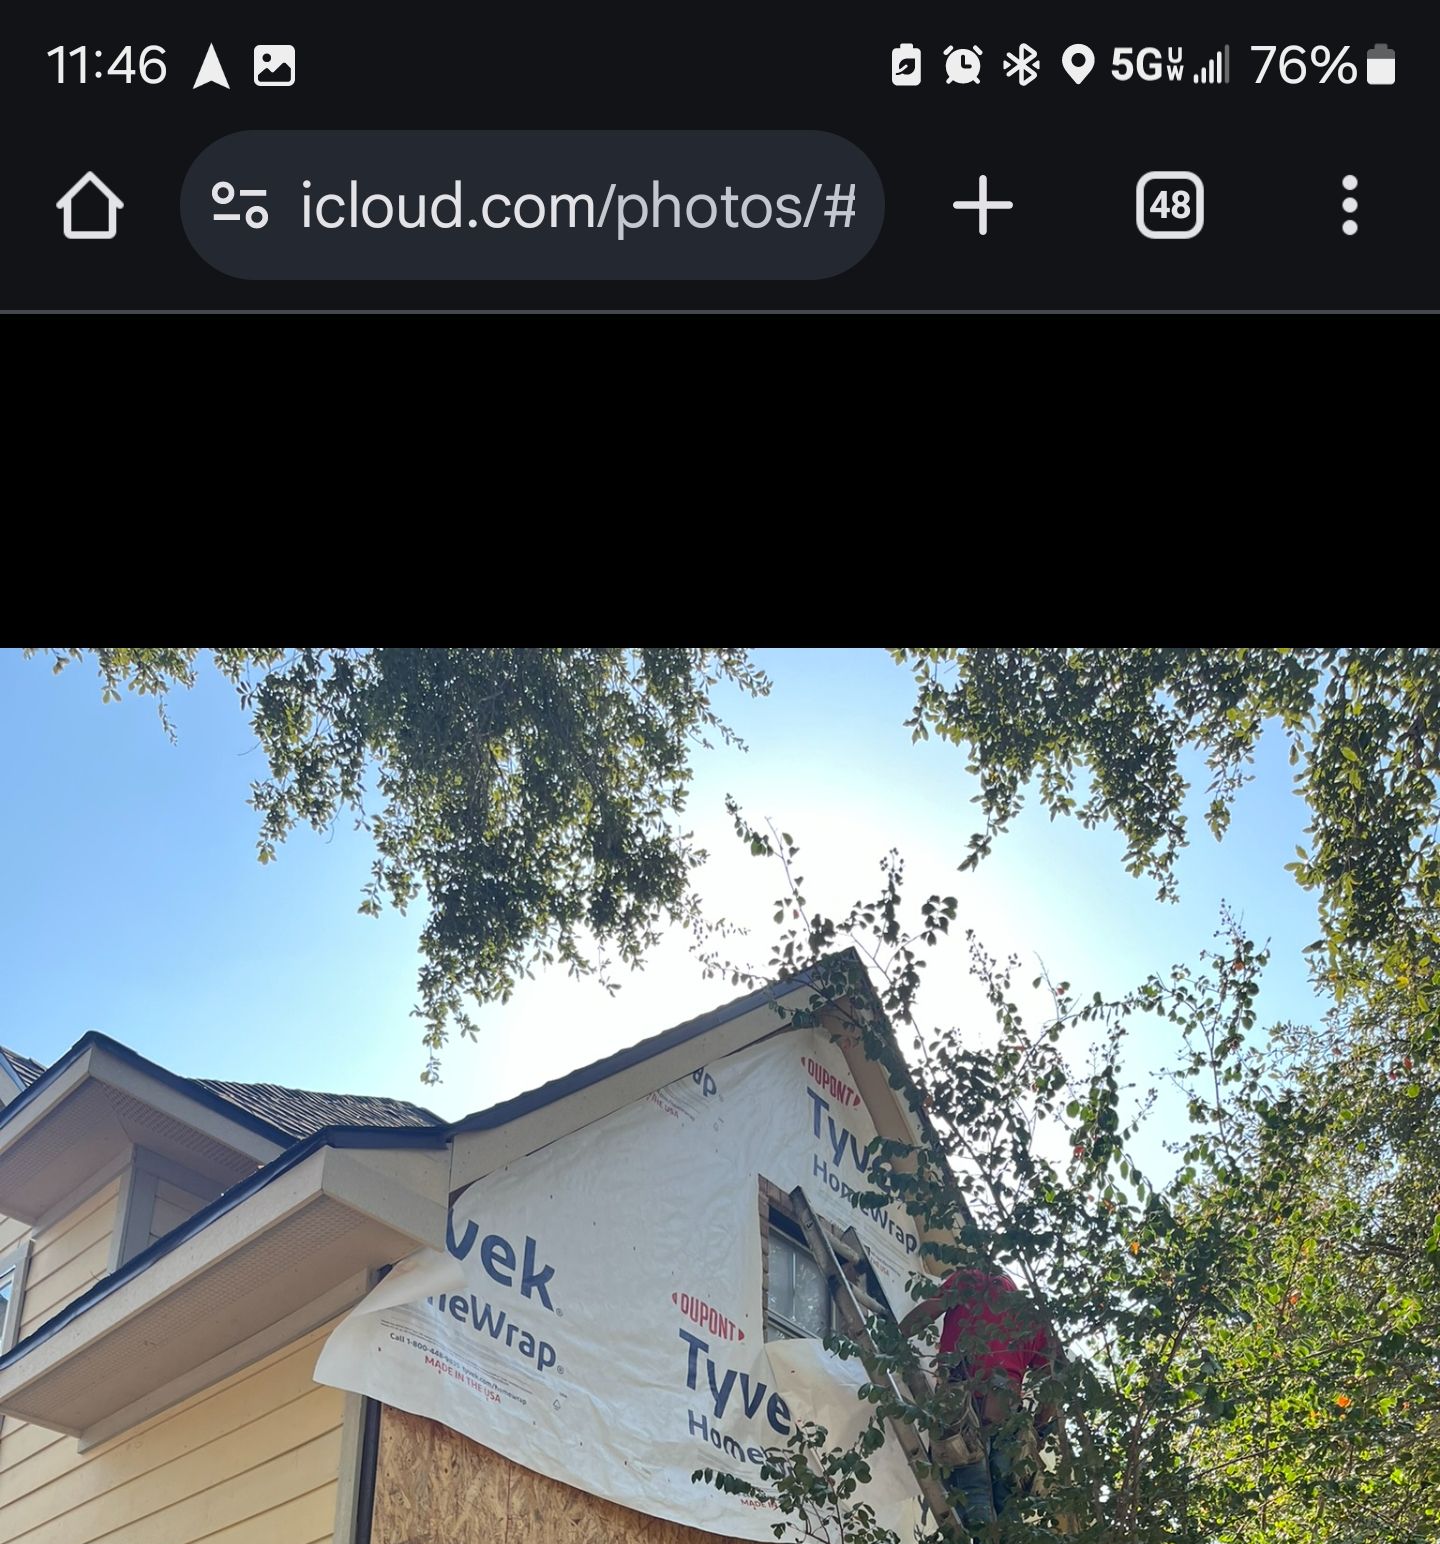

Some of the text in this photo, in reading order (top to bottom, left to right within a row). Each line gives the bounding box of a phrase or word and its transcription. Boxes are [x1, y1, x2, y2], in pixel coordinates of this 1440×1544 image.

[47, 45, 167, 84] 11:46
[1250, 45, 1358, 85] 76%
[302, 179, 857, 241] icloud.com/photos/#
[1149, 190, 1191, 219] 48
[807, 1058, 855, 1107] DUPONT
[680, 1293, 736, 1341] DUPONT
[389, 1332, 405, 1343] Call
[425, 1355, 501, 1404] MADE IN THE USA
[740, 1498, 767, 1508] MADE
